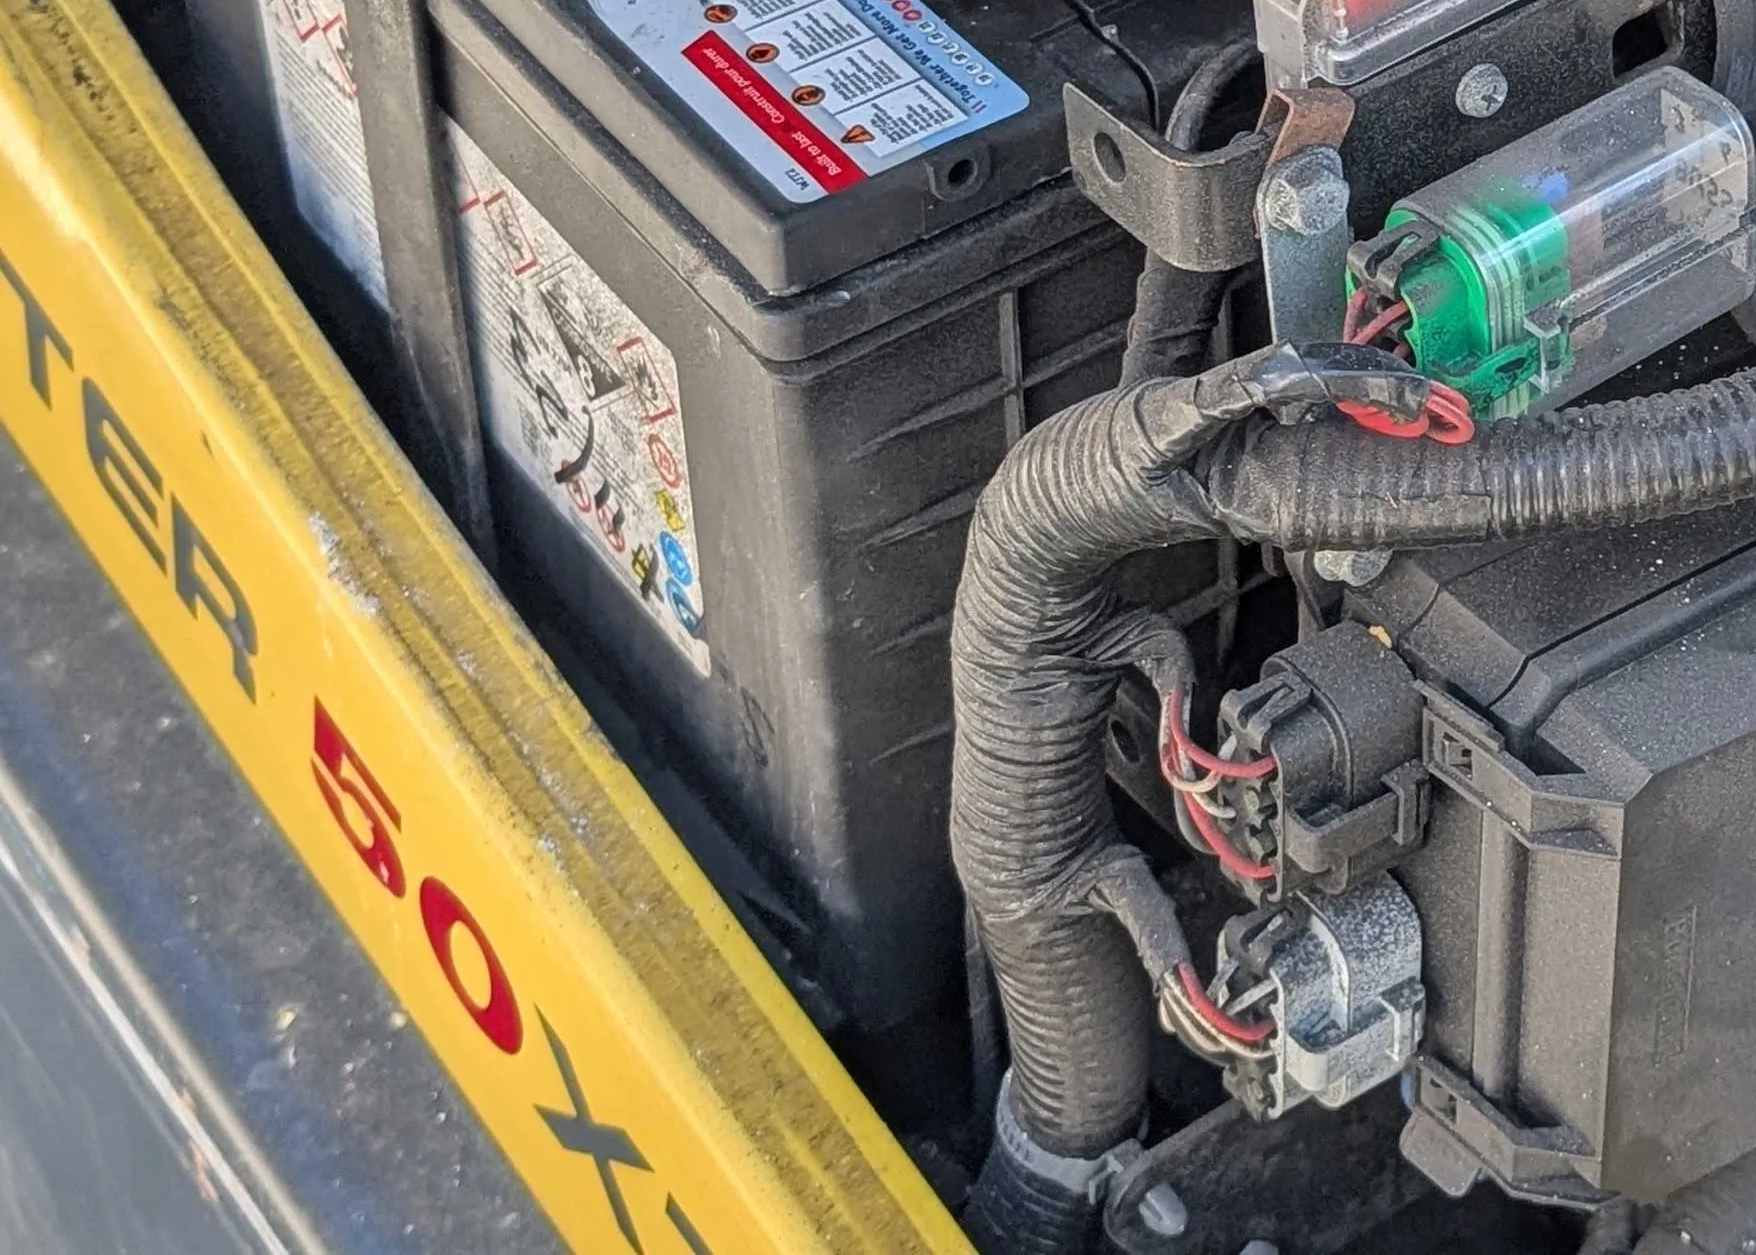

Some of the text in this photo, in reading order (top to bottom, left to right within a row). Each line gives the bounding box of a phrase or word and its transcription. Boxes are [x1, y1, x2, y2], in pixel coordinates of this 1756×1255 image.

[867, 10, 899, 34] More
[892, 33, 918, 51] Get
[910, 48, 933, 65] We
[925, 61, 979, 103] Together
[699, 46, 843, 176] Built to last Construit pour durer
[578, 351, 596, 401] 8
[310, 697, 713, 1255] 50X
